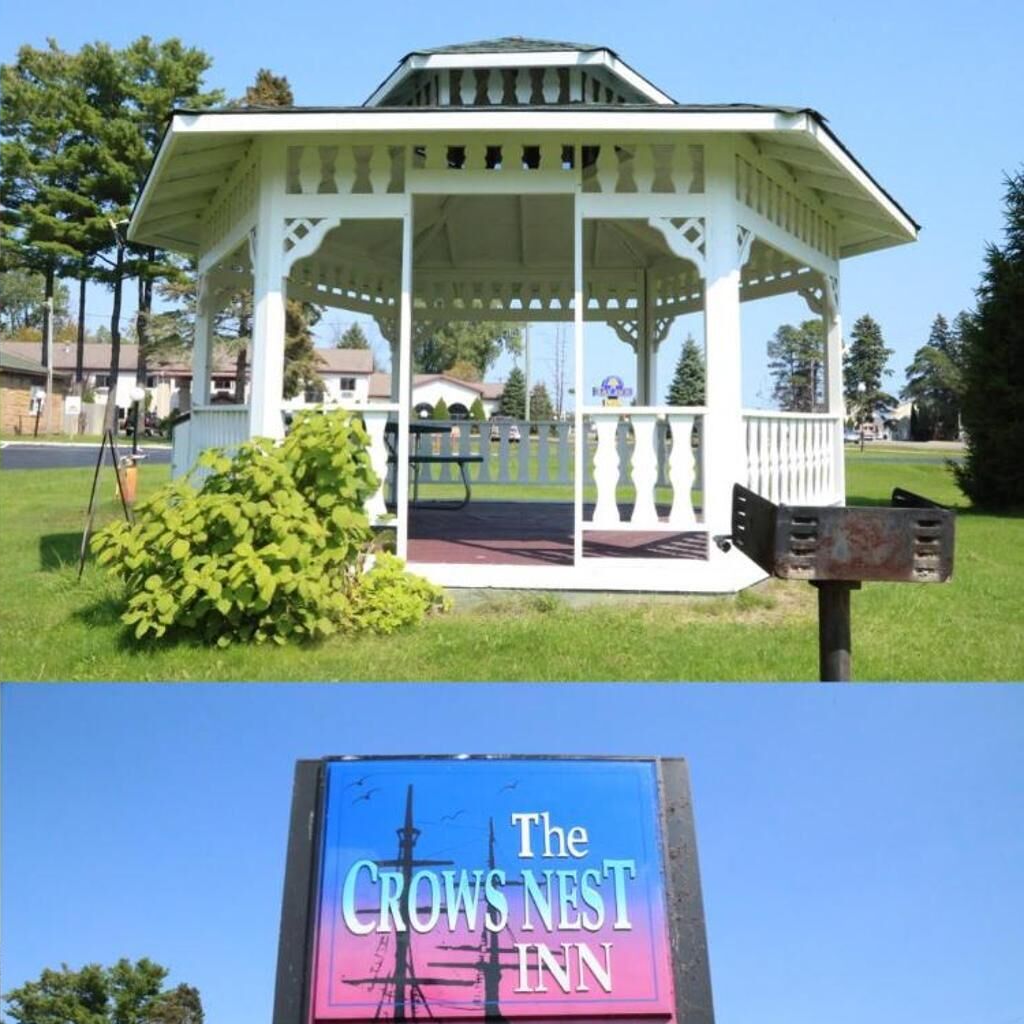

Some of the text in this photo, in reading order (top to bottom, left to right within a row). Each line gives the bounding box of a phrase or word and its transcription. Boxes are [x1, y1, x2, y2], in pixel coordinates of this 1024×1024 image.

[511, 812, 589, 859] The
[341, 859, 635, 934] CROWS NEST
[512, 942, 613, 994] INN
